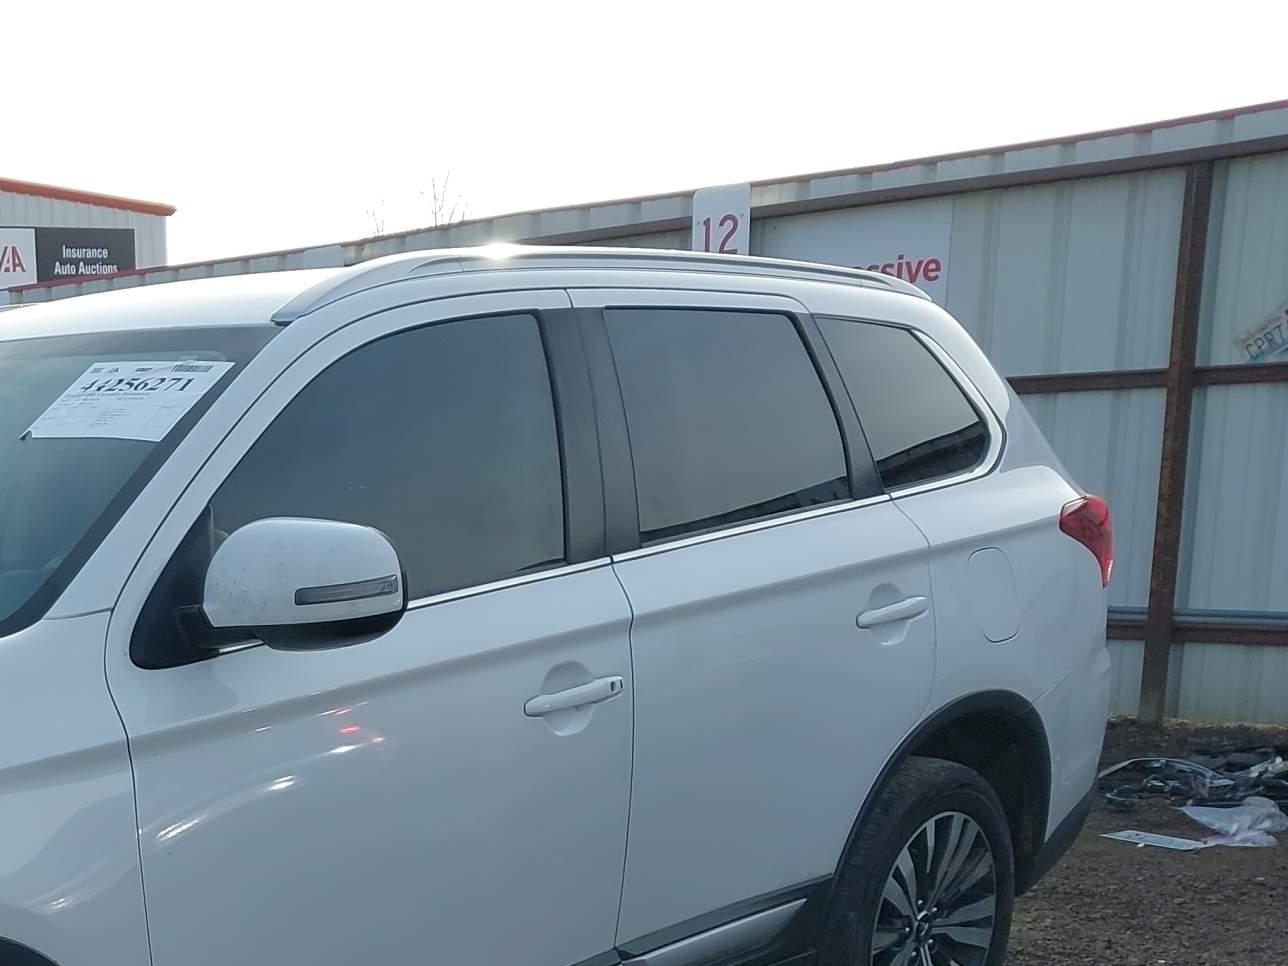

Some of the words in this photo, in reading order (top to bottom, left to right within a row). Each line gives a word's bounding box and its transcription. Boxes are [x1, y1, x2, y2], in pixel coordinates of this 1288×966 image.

[701, 212, 739, 254] 12
[62, 244, 109, 259] Insurance
[54, 261, 77, 275] Auto
[78, 261, 119, 276] Auctions
[81, 377, 195, 392] 44256271
